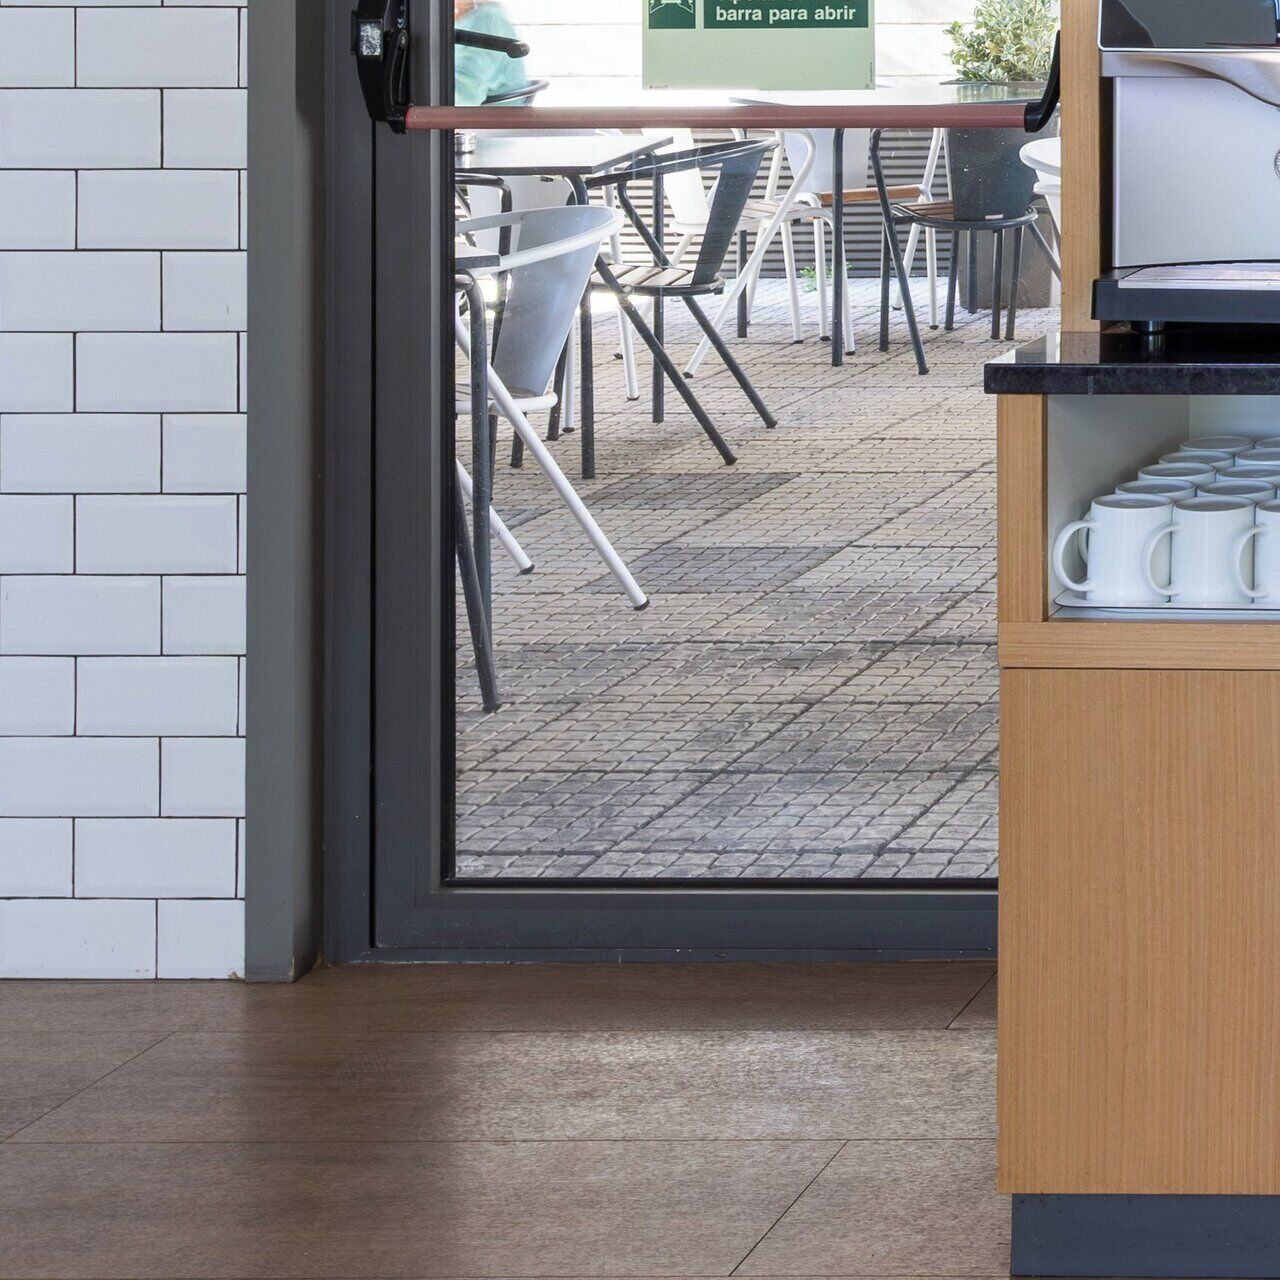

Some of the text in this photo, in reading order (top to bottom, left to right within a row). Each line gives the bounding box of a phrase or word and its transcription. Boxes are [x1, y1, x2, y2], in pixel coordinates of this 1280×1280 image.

[717, 6, 856, 24] barra para abrir
